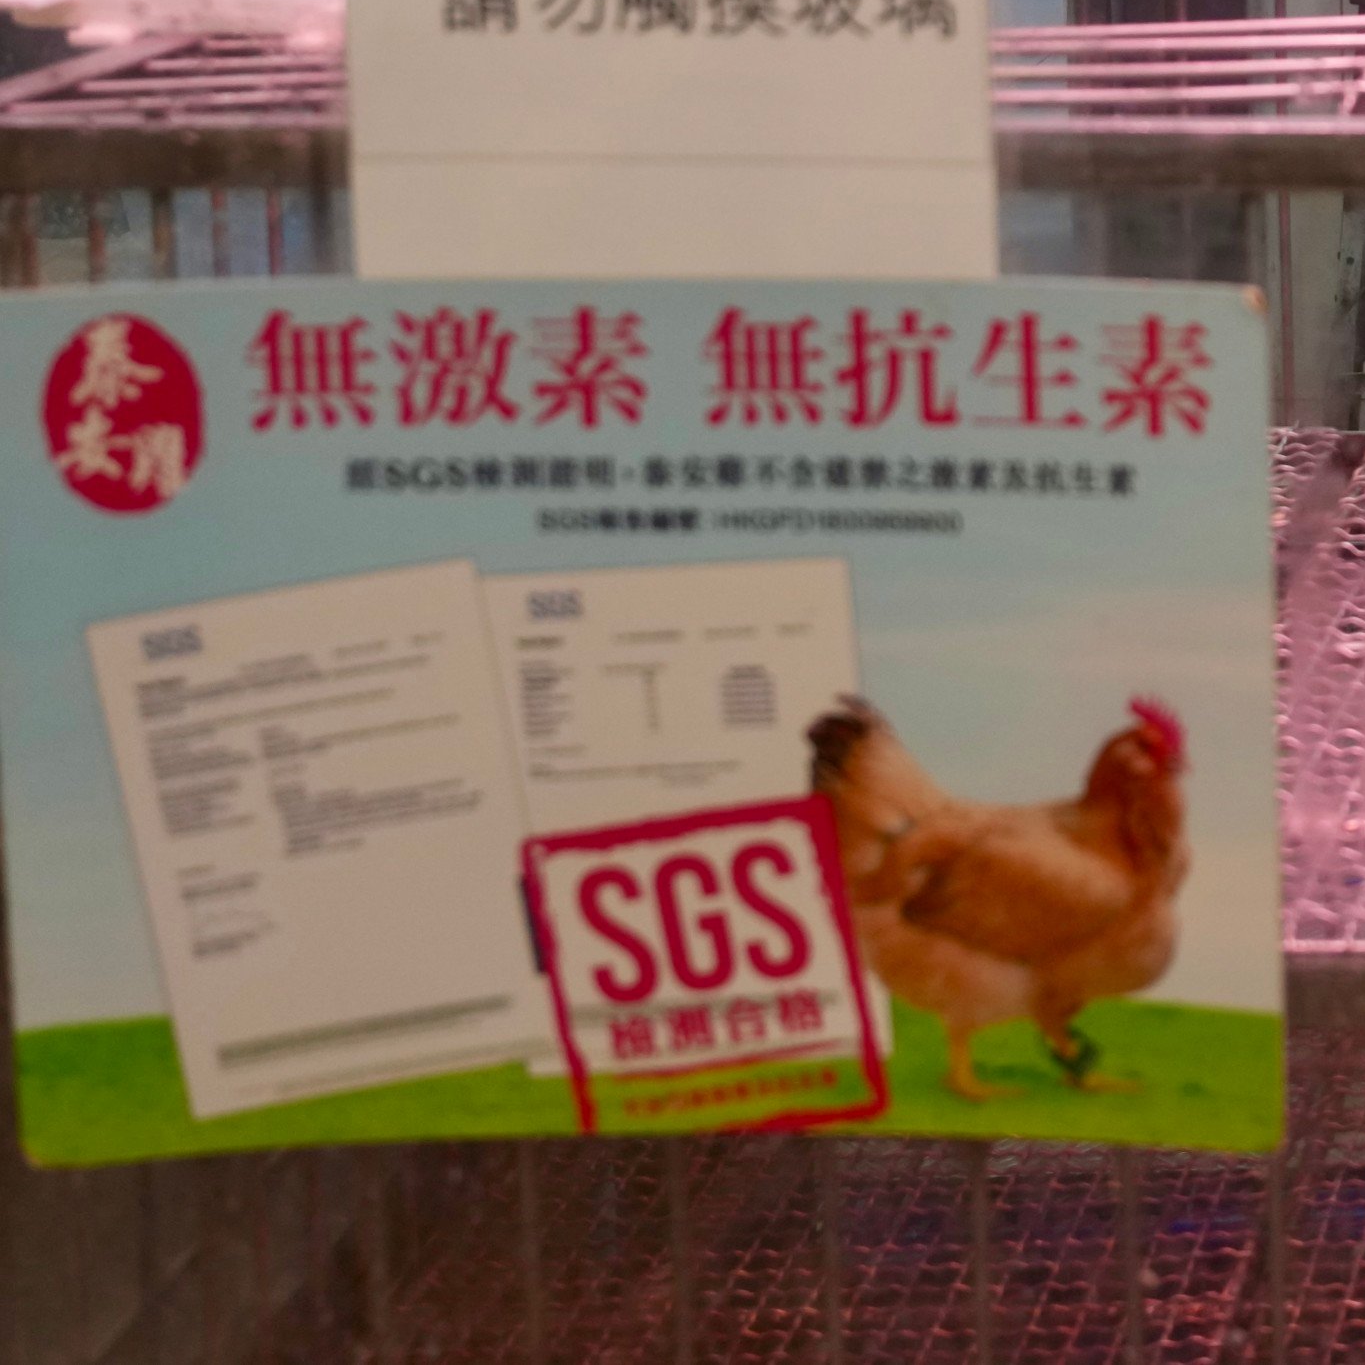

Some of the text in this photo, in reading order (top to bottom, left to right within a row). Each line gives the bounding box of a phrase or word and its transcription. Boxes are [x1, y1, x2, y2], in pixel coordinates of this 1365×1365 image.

[246, 306, 1214, 440] 無激素 無抗生素
[576, 838, 811, 1005] SGS
